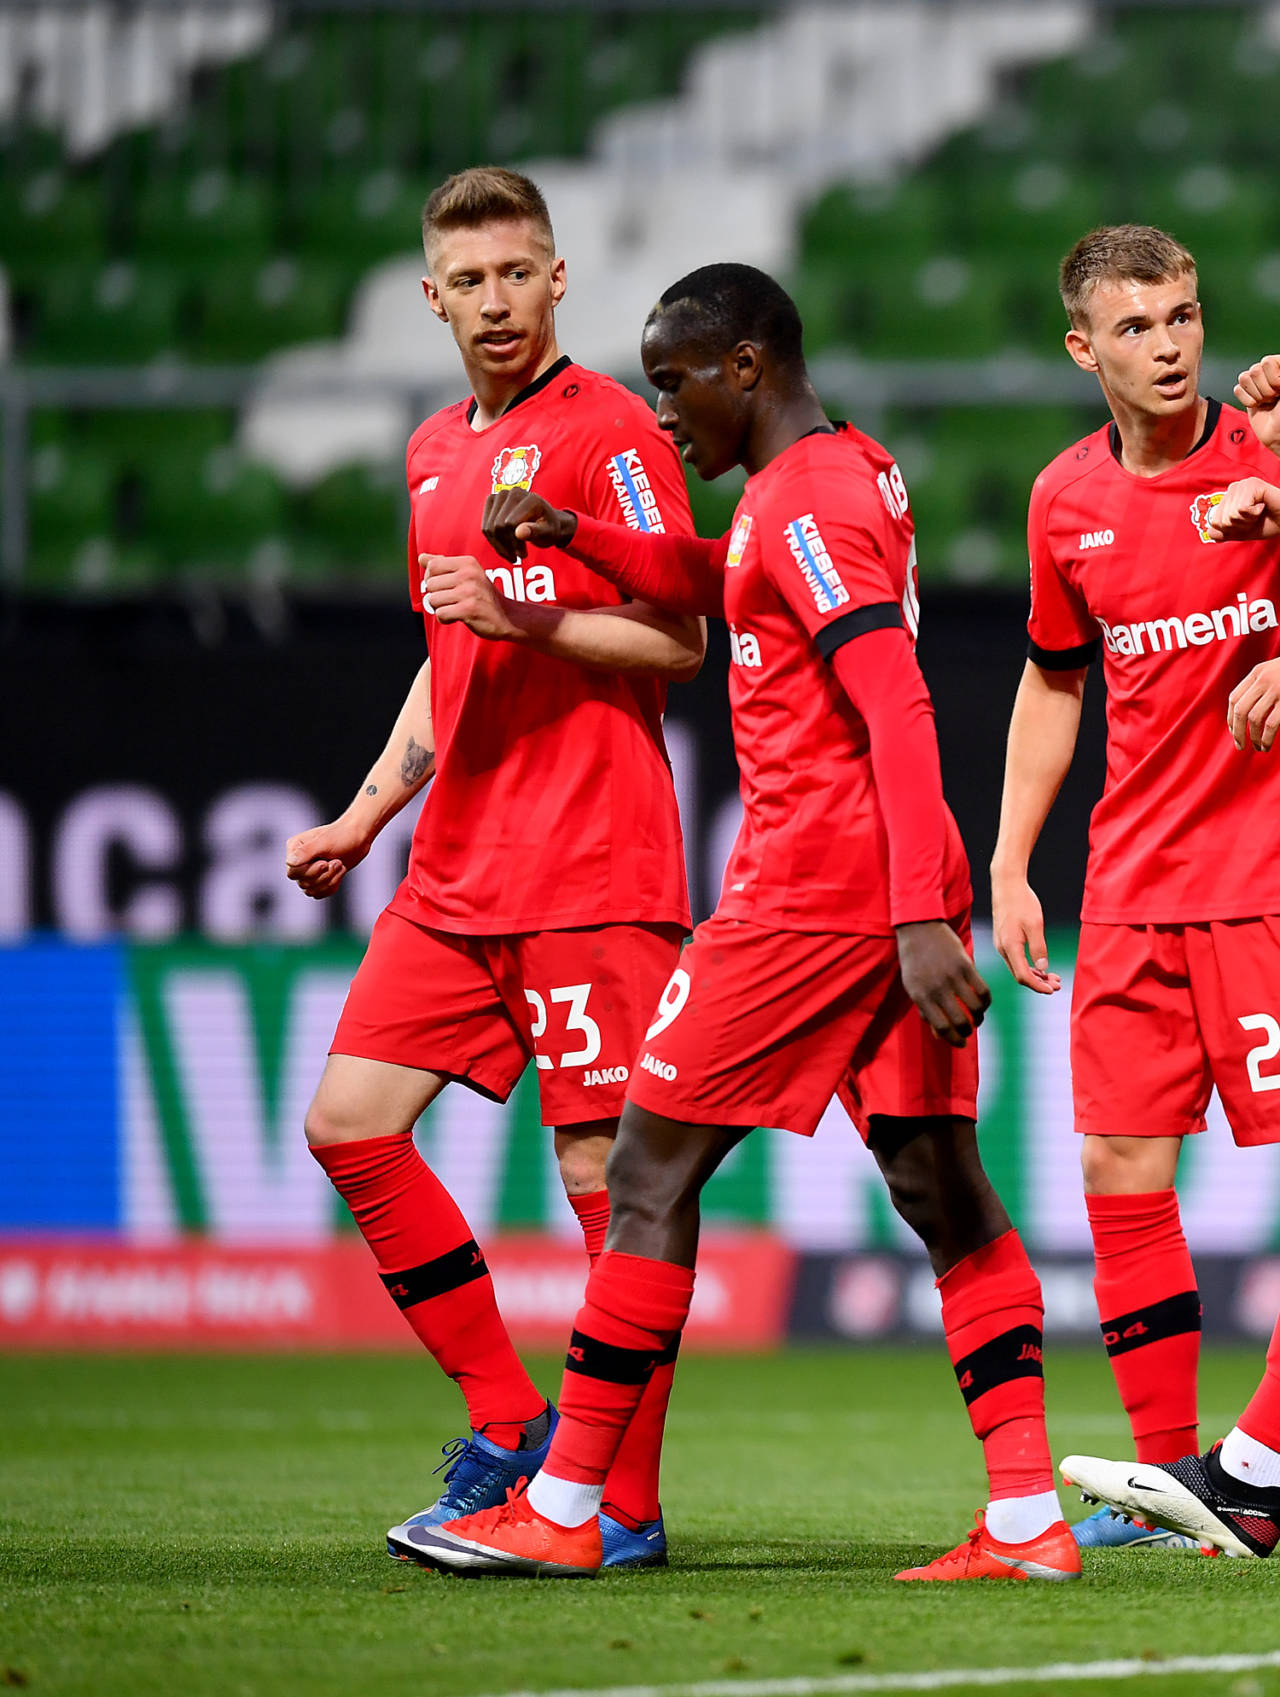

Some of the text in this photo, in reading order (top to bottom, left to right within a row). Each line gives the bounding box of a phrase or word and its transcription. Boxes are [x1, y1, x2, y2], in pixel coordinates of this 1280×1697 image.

[606, 457, 640, 530] TRAINI
[783, 522, 832, 613] TRAINING
[798, 513, 850, 606] KIESER
[1078, 529, 1115, 550] JAKO
[1096, 592, 1279, 656] Barmenia
[524, 983, 602, 1070] 23
[583, 1066, 629, 1087] JAKO
[640, 1053, 678, 1082] JAKO
